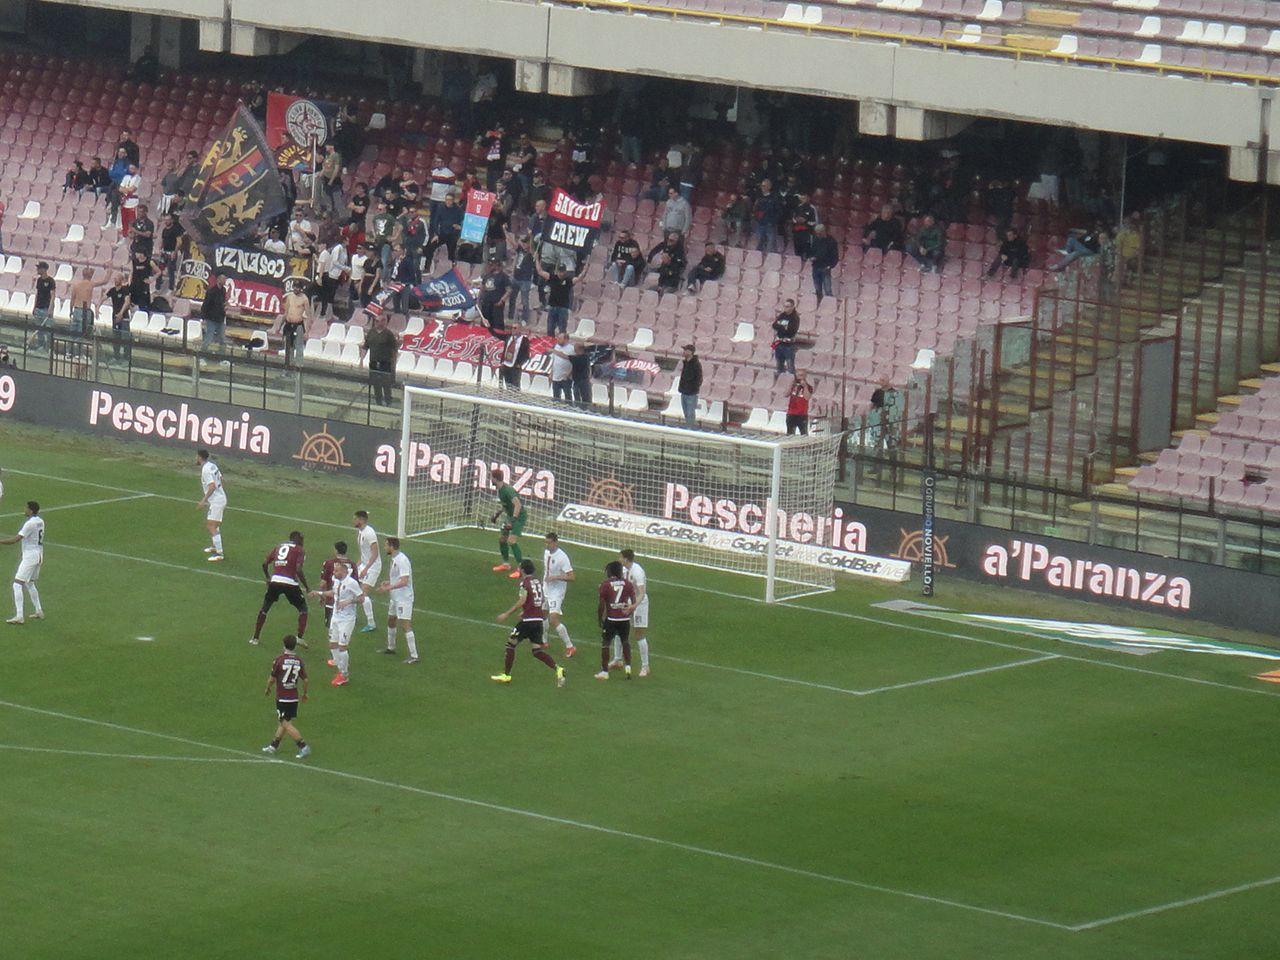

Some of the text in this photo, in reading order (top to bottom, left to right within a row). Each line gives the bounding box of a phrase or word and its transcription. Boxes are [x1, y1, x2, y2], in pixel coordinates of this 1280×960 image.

[550, 221, 590, 248] CREW
[215, 246, 285, 279] COSENZA
[223, 278, 280, 314] ULTR
[89, 390, 271, 455] Pescheria
[664, 482, 867, 553] Pescheria
[984, 540, 1192, 609] a'Paranza
[731, 537, 794, 558] Goldet
[923, 487, 933, 585] GRUPPO NOVIELLO
[277, 545, 289, 561] 9
[614, 585, 624, 604] 7
[282, 664, 301, 684] 73
